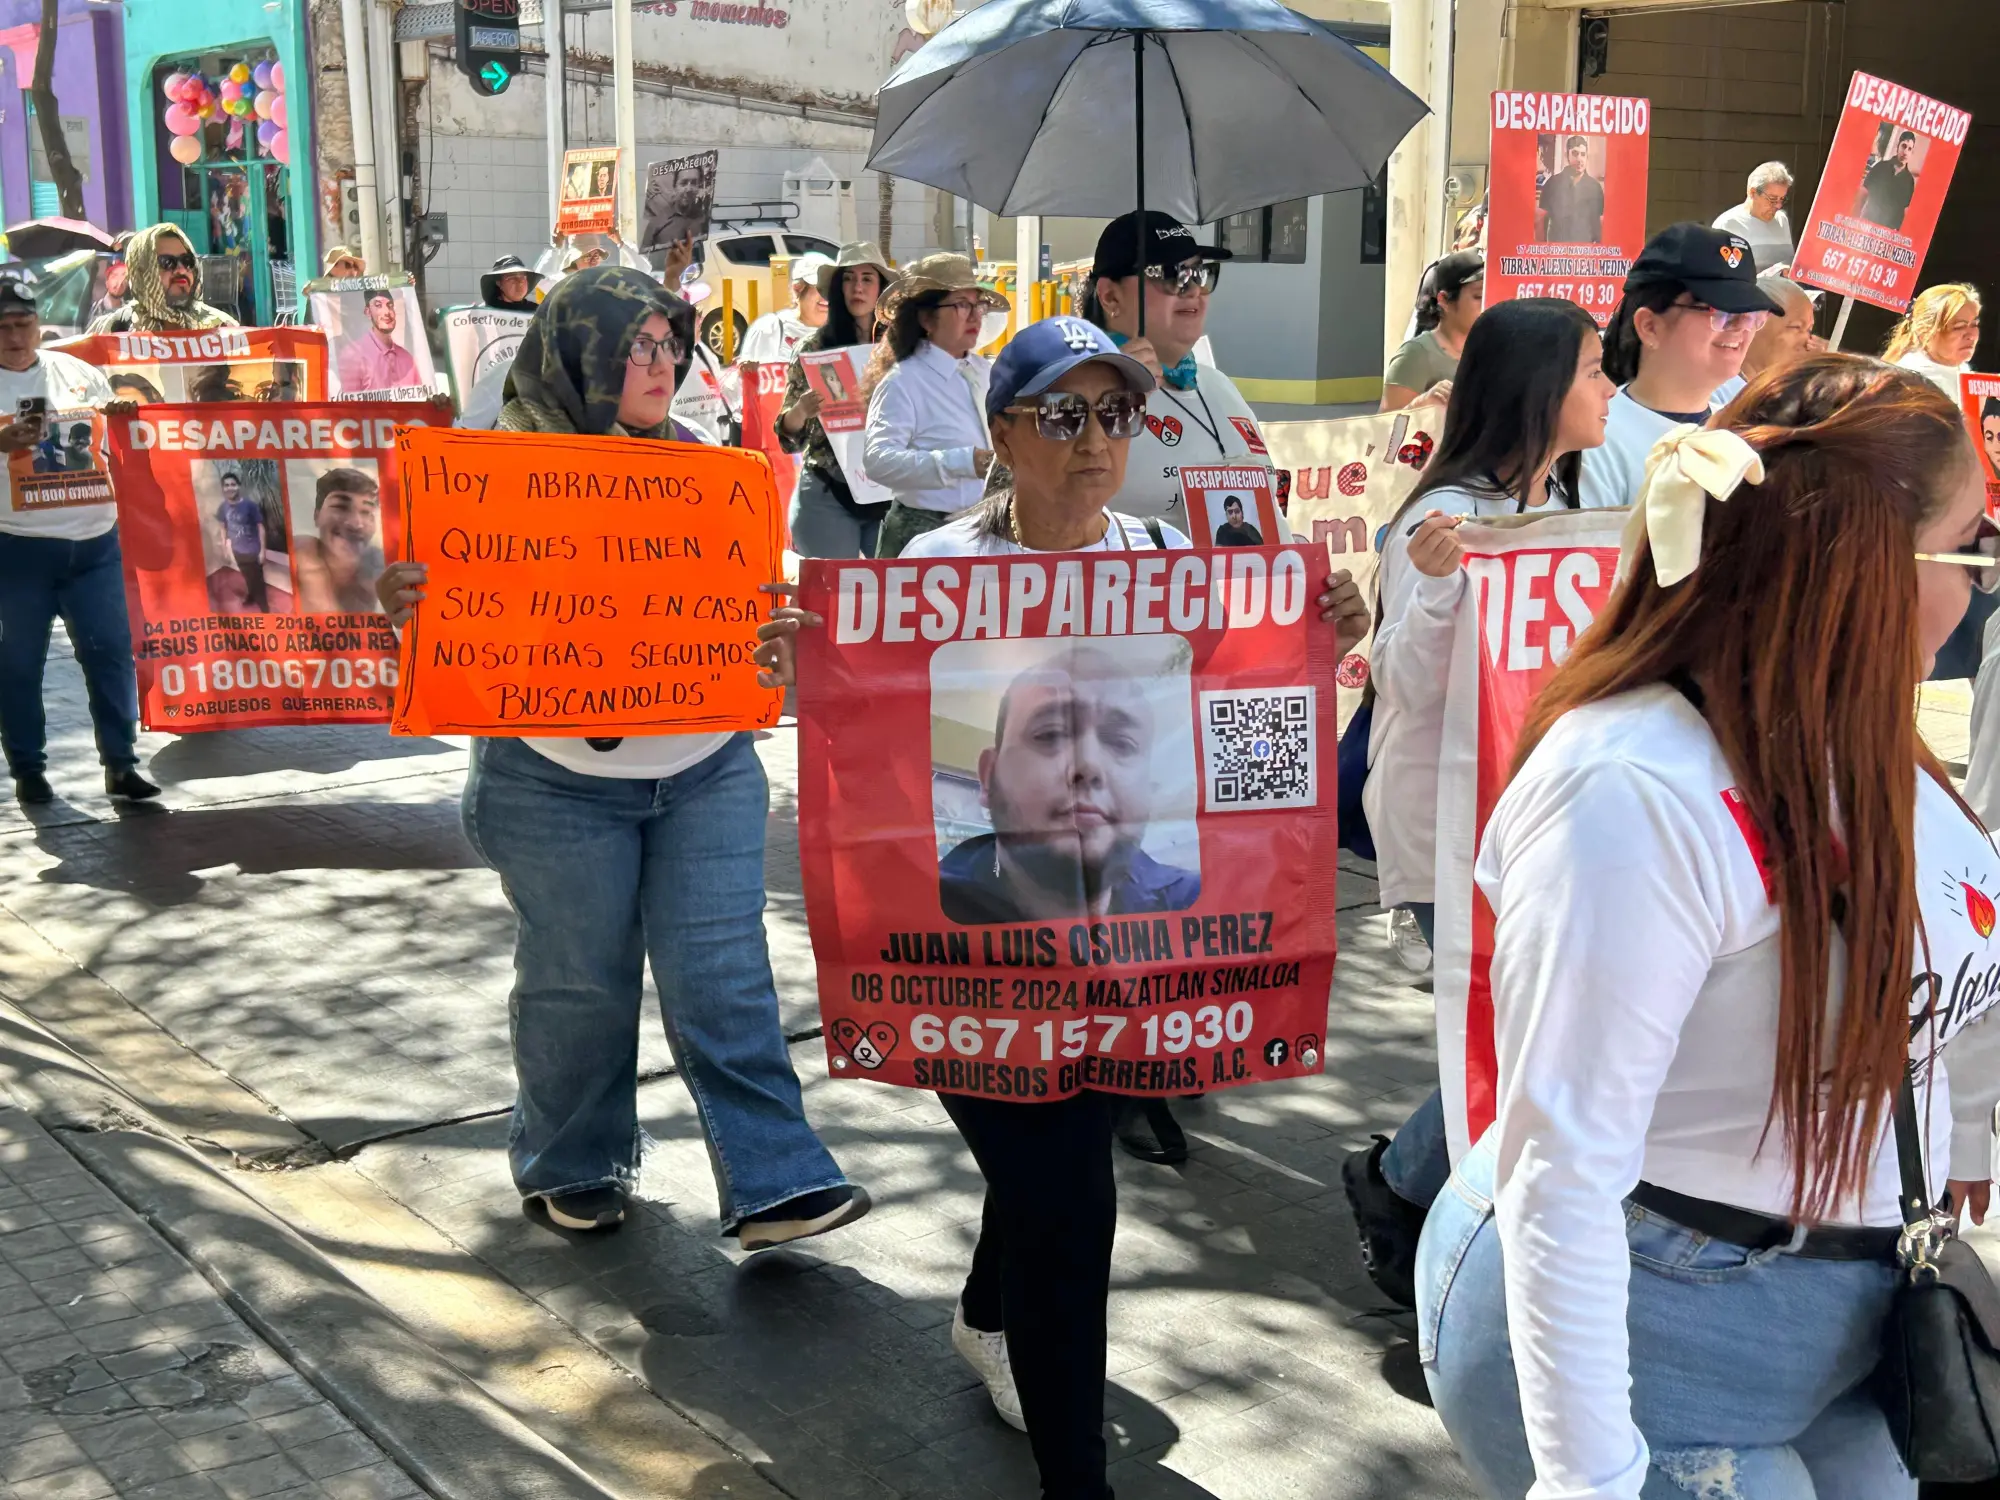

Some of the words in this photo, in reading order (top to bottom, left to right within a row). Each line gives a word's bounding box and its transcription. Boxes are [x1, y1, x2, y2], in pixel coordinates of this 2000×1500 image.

[475, 31, 517, 47] ABIERTO
[1495, 92, 1647, 135] DESAPARECIDO
[1850, 74, 1969, 146] DESAPARECIDO
[653, 154, 714, 176] DESAPARECIDO
[1817, 221, 1847, 244] YIBRAN
[1501, 257, 1537, 276] YIBRAN
[1539, 258, 1573, 276] ALEXIS
[1574, 258, 1597, 276] LEAL
[1821, 247, 1847, 272] 667
[1847, 255, 1869, 280] 157
[1868, 263, 1884, 283] 19
[1882, 268, 1898, 288] 30
[1516, 283, 1544, 300] 667
[1548, 283, 1574, 301] 157
[1577, 284, 1594, 304] 19
[1598, 284, 1615, 304] 30
[453, 313, 507, 327] Colectivo
[509, 316, 524, 328] de
[118, 333, 251, 361] JUSTICIA
[128, 418, 429, 450] DESAPARECID
[527, 471, 703, 505] ABRAZAMOS
[728, 480, 756, 515] A
[1185, 470, 1267, 489] DESAPARECIDO
[440, 526, 578, 564] QUIENES
[597, 533, 702, 563] TIENEN
[727, 539, 748, 568] A
[440, 585, 505, 620] SUS
[530, 590, 618, 624] HIJOS
[643, 594, 683, 617] EN
[692, 595, 759, 623] CASA
[836, 549, 1308, 645] DESAPARECIDO
[1466, 553, 1620, 671] DES
[143, 622, 165, 637] 04
[169, 616, 265, 634] DICIEMBRE
[275, 616, 321, 633] 2018,
[137, 635, 199, 660] JESUS
[204, 632, 279, 653] IGNACIO
[285, 631, 362, 653] ARAGON
[433, 640, 604, 669] NOSOTRAS
[161, 656, 400, 697] 0180067036
[184, 697, 271, 718] SABUESOS
[282, 696, 383, 712] GUERRERAS,
[881, 931, 970, 965] JUAN
[983, 926, 1057, 967] LUIS
[1068, 918, 1173, 967] OSUNA
[1181, 911, 1274, 957] PEREZ
[851, 973, 883, 1003] 08
[890, 974, 1004, 1010] OCTUBRE
[1011, 979, 1078, 1011] 2024
[1086, 970, 1206, 1008] MAZATLAN
[1211, 961, 1300, 995] SINALOA
[910, 1013, 1019, 1059] 667
[1033, 1015, 1128, 1061] 157
[1141, 1000, 1253, 1056] 1930
[913, 1057, 1048, 1097] SABUESOS
[1058, 1054, 1204, 1093] GUERRERAS,
[1212, 1047, 1252, 1083] A.C.
